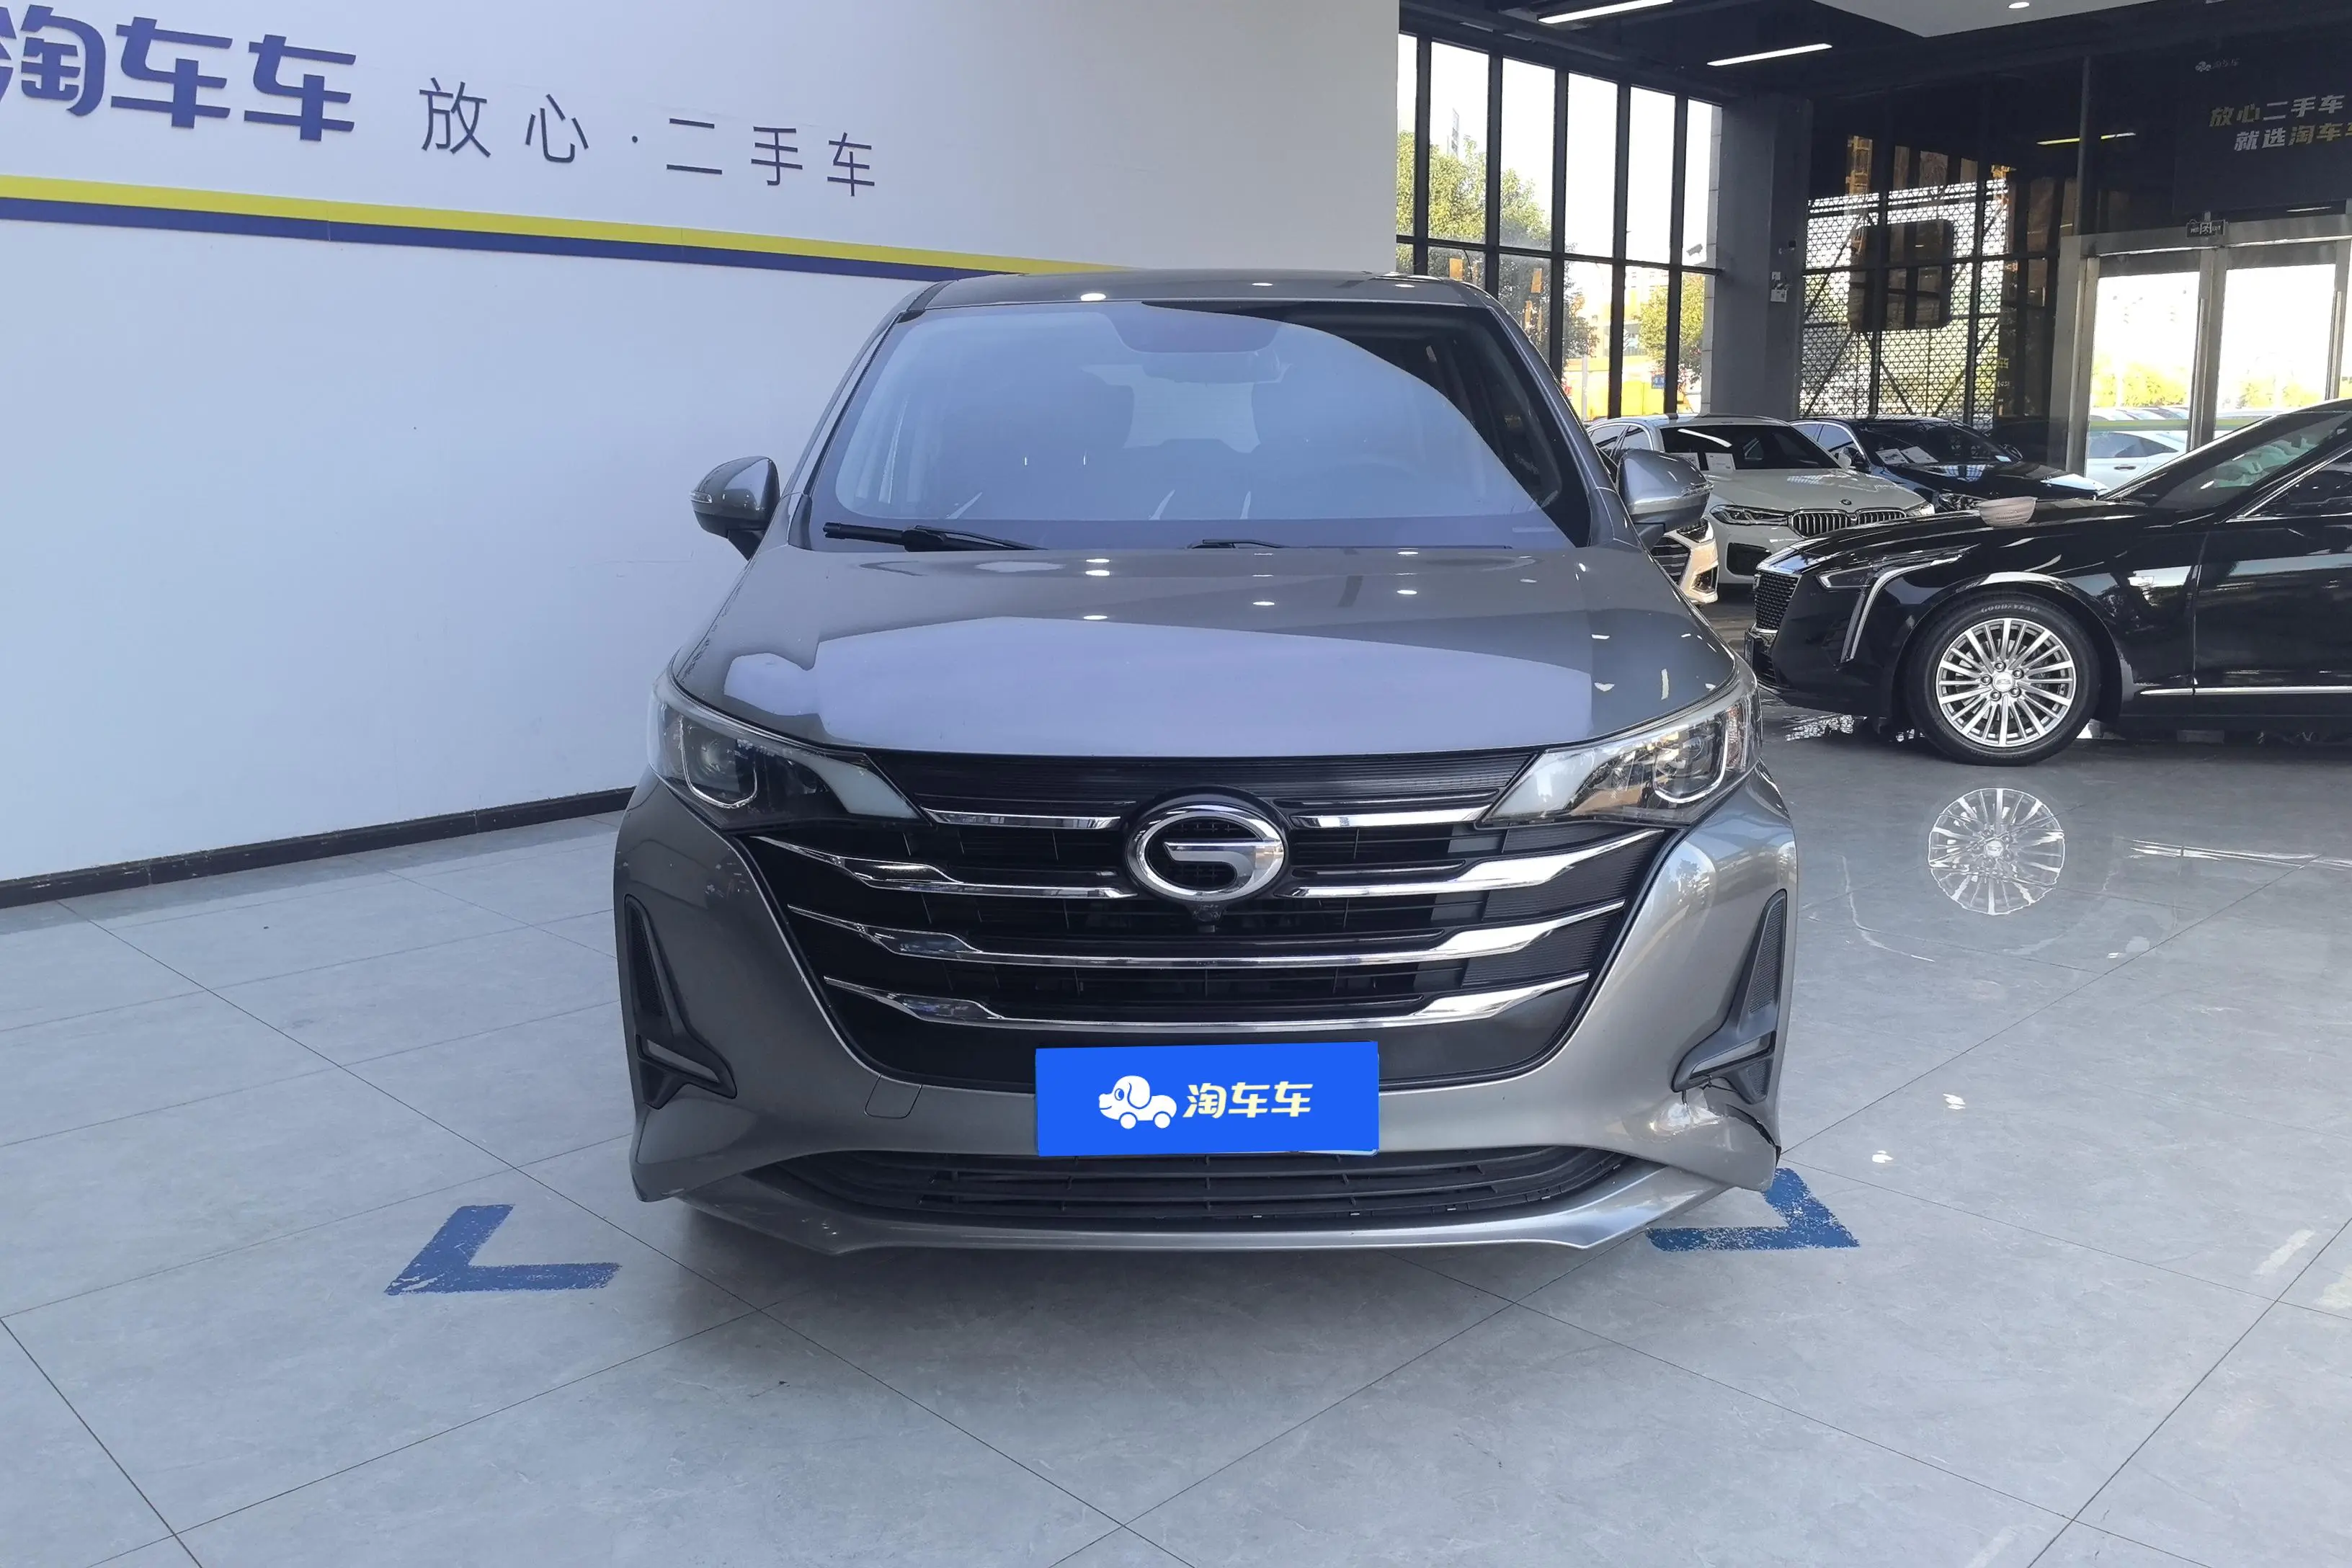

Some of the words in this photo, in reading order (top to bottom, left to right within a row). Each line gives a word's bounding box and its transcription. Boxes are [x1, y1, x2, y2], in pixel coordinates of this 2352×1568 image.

[0, 4, 356, 141] 淘车车
[2209, 94, 2346, 128] 放心二手车
